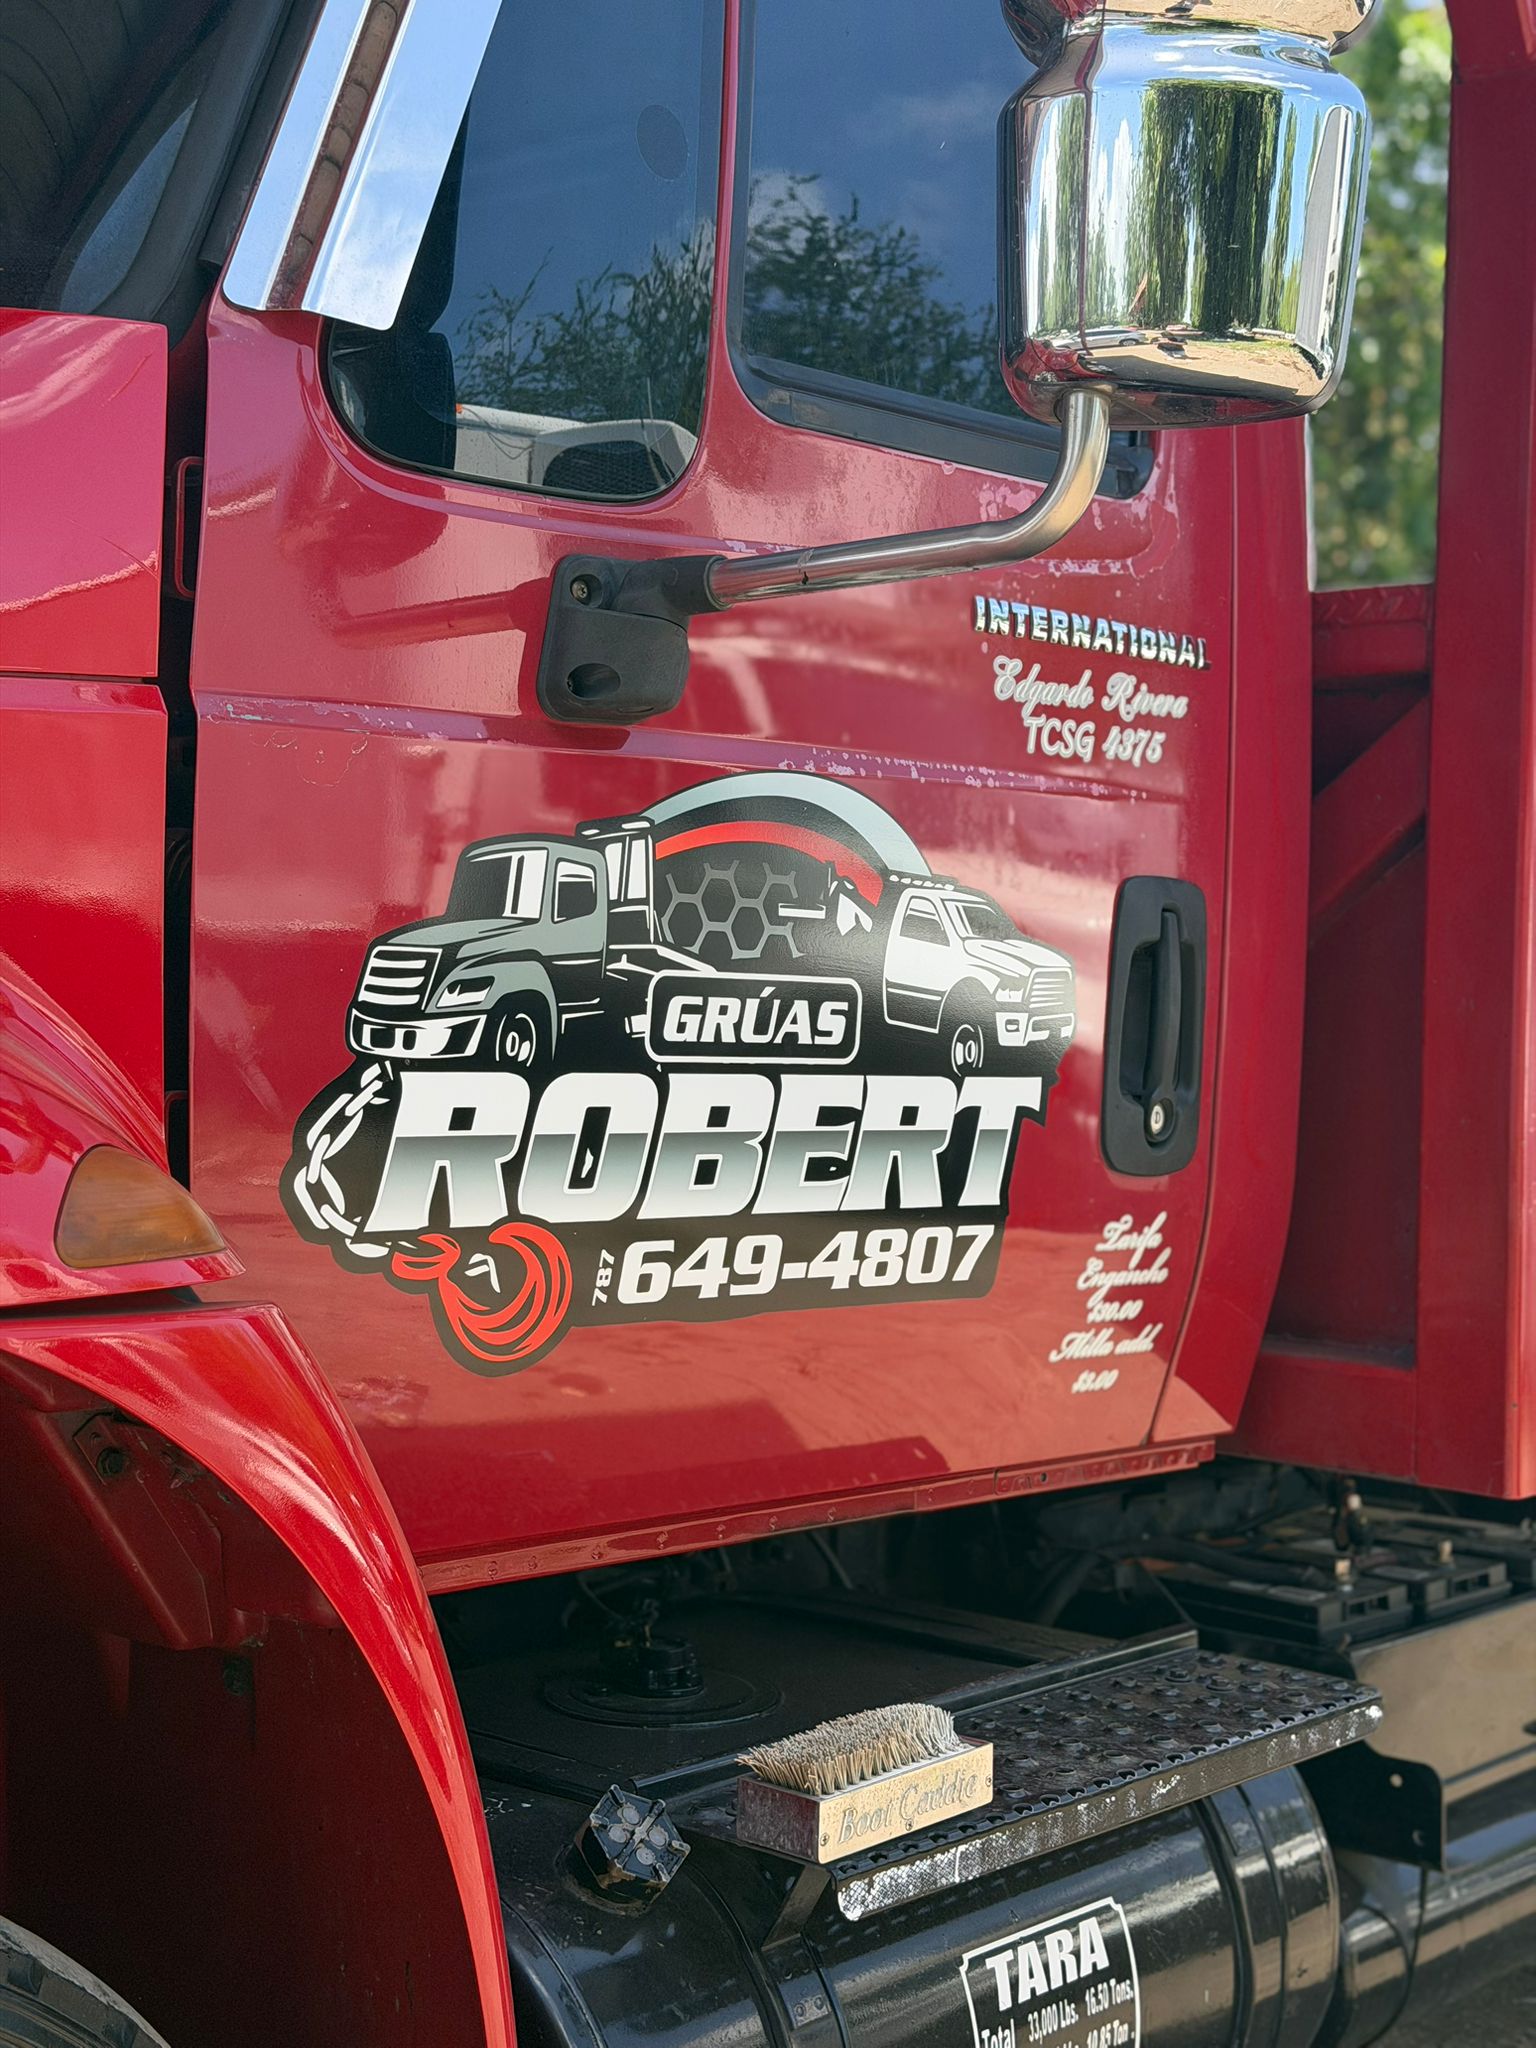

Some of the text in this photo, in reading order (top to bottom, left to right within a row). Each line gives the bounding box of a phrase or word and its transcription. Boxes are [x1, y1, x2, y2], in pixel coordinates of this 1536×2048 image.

[972, 595, 1211, 669] INTERNATIONAL
[993, 655, 1189, 722] Edgardo Rivera
[1024, 714, 1166, 768] TCSG 4375
[663, 986, 849, 1045] GRÚAS
[364, 1071, 1042, 1233] ROBERT
[592, 1224, 995, 1306] 787 649-4807
[1094, 1211, 1167, 1270] Tarifa
[1076, 1247, 1172, 1310] Enganche
[985, 1916, 1109, 2012] TARA
[1028, 2003, 1059, 2045] 33,000
[1059, 1998, 1080, 2028] Lbs.
[1085, 1981, 1109, 2016] 16.50
